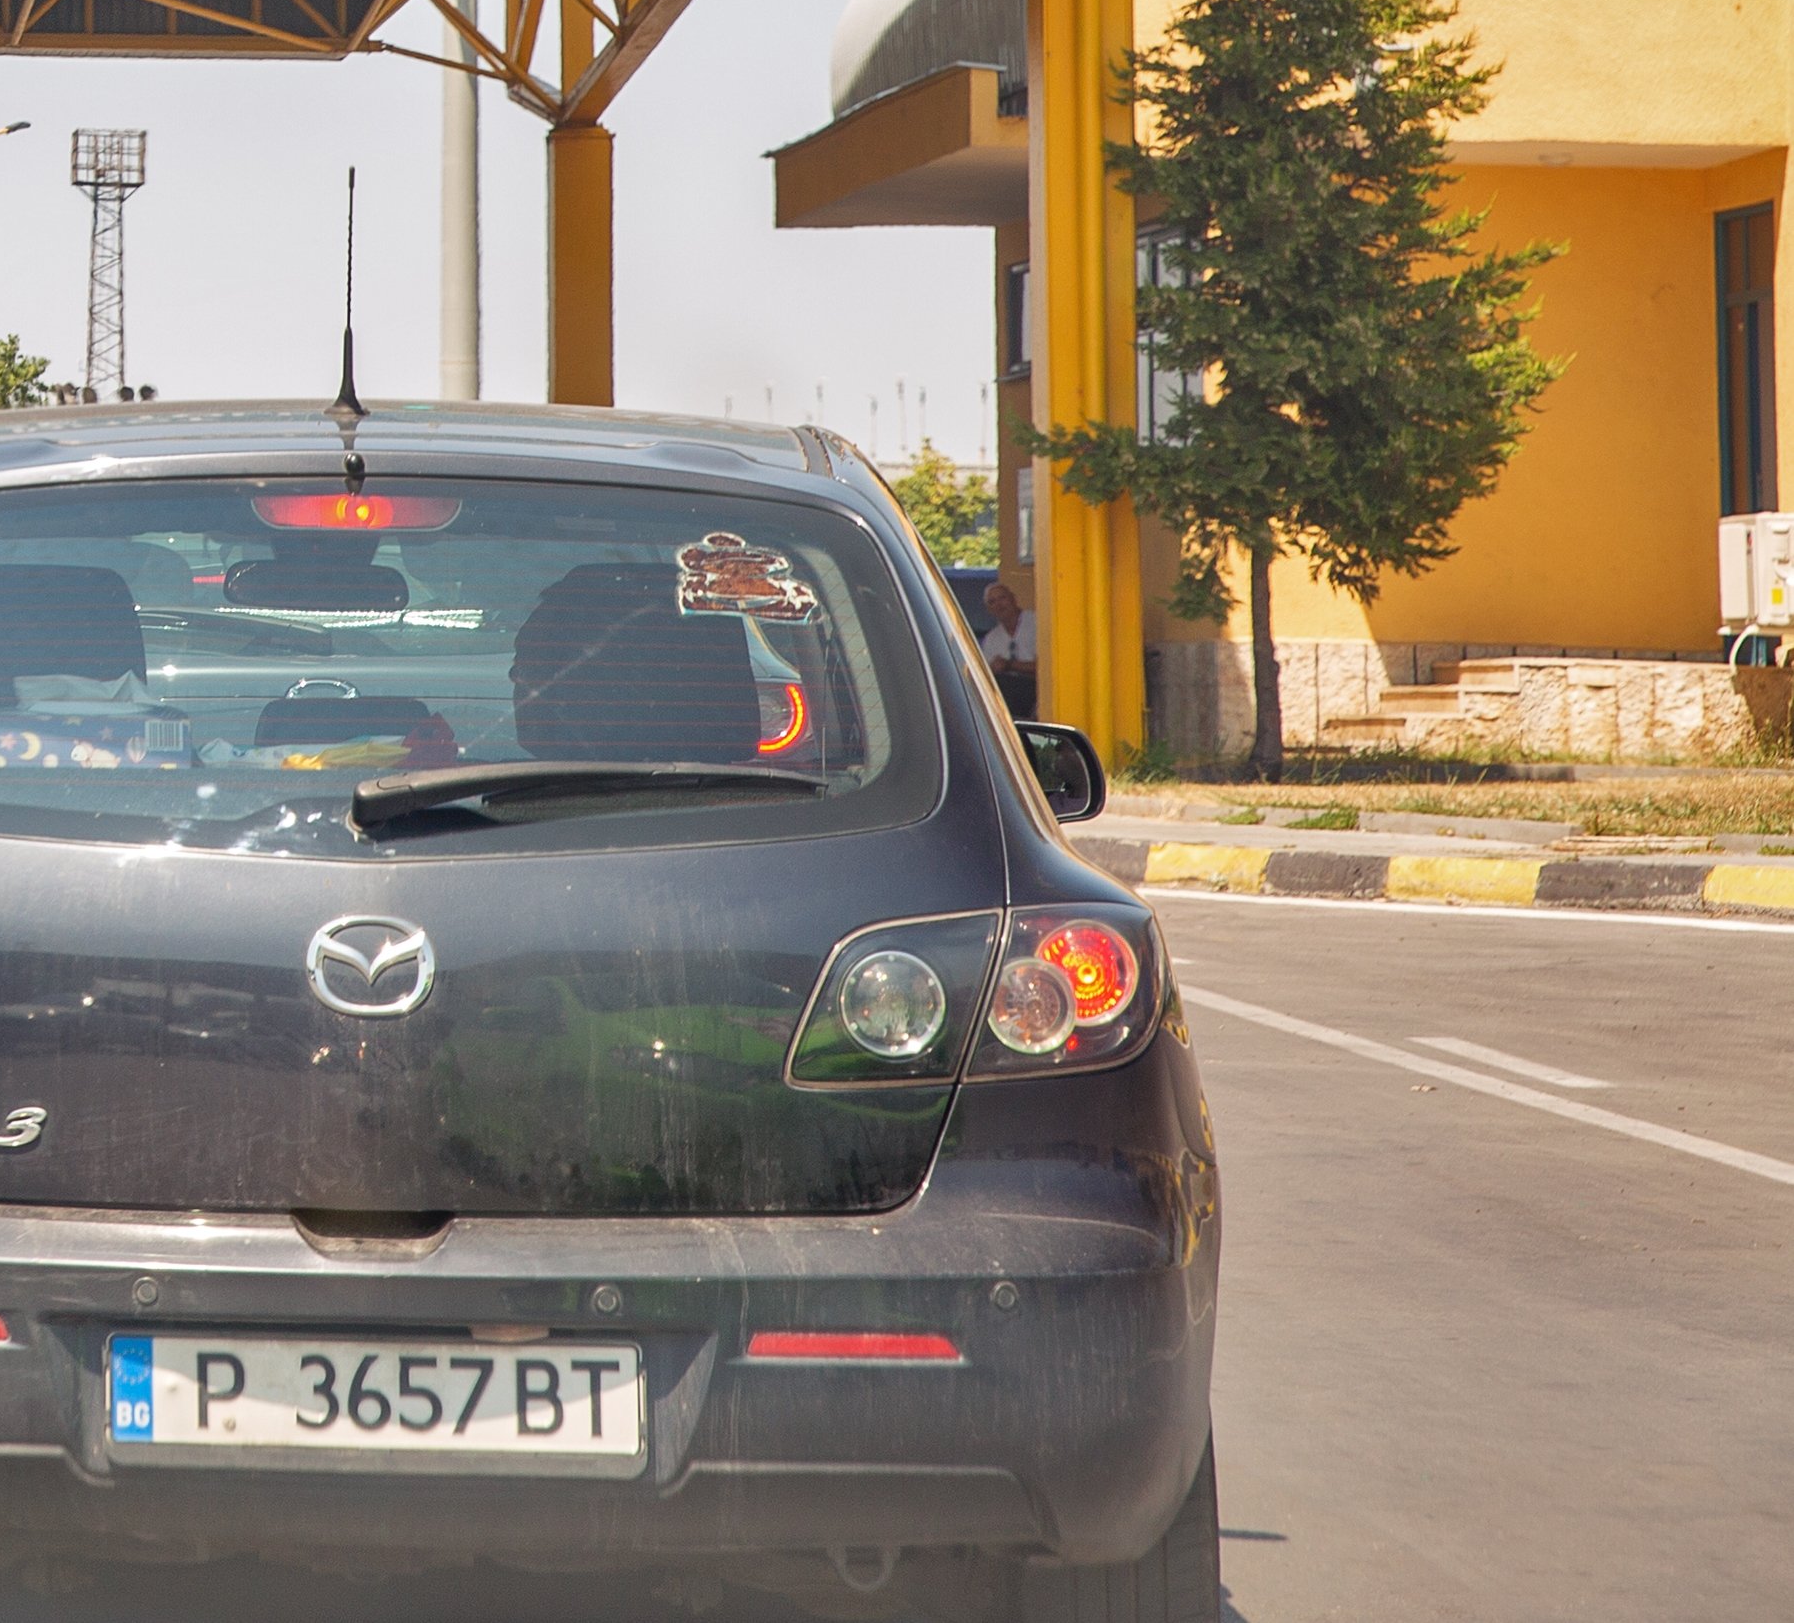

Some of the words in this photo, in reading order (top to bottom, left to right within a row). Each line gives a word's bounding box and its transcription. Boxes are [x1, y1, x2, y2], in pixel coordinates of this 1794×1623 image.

[115, 1400, 151, 1430] BG
[195, 1350, 247, 1430] P
[295, 1354, 496, 1437] 3657
[516, 1358, 622, 1440] BT
